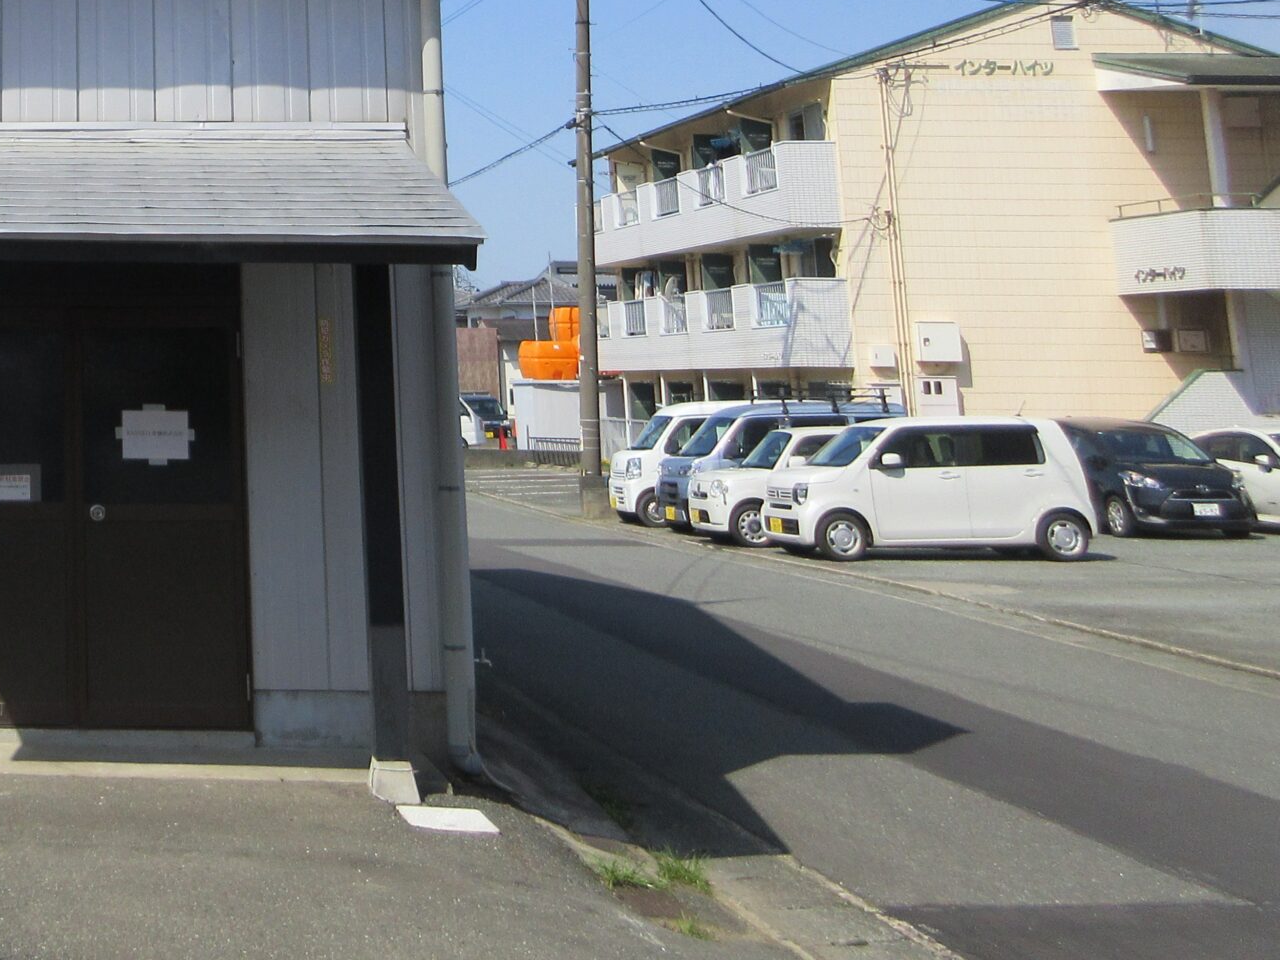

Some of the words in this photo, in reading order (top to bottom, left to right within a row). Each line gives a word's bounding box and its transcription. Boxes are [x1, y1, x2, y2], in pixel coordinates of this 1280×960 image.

[955, 59, 1054, 76] インターハイツ
